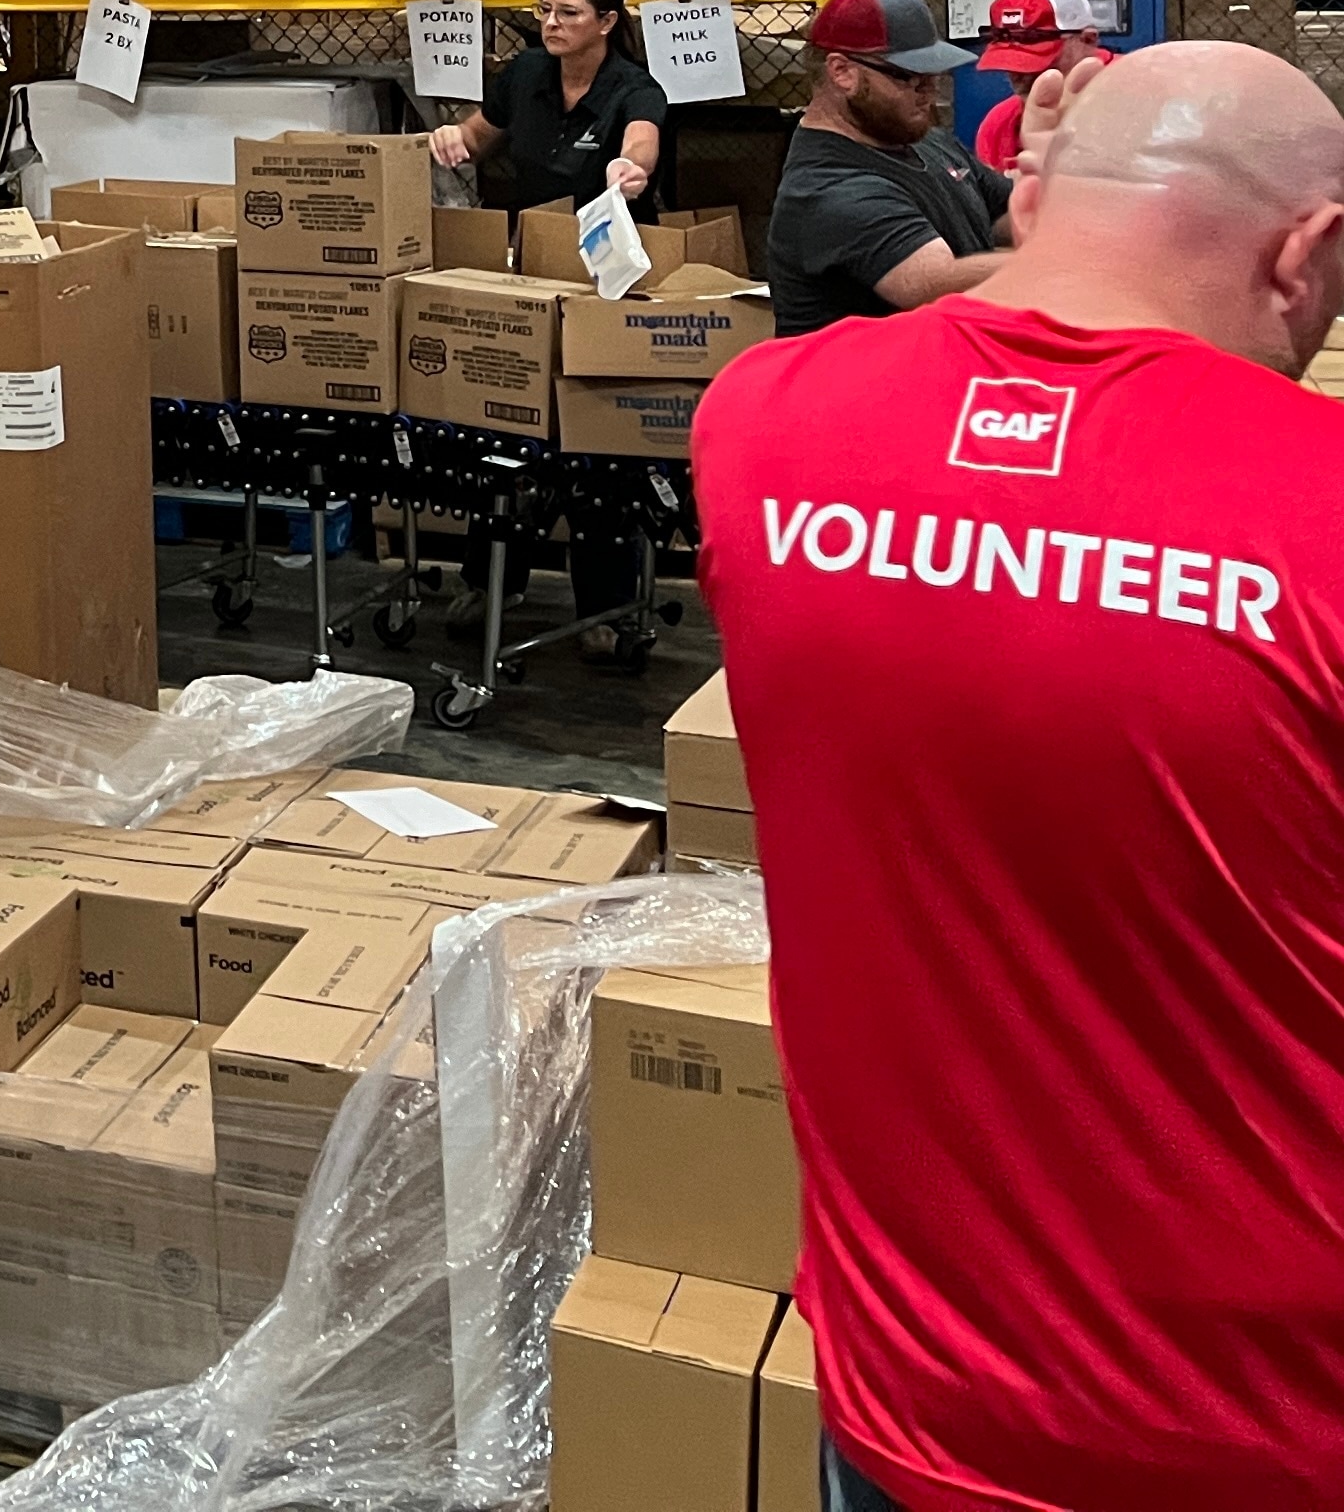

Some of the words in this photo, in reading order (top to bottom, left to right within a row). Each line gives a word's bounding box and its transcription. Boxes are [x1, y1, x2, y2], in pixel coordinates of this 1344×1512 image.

[103, 8, 141, 29] PASTA
[419, 11, 474, 23] POTATO
[654, 6, 721, 24] POWDER
[105, 33, 114, 44] 2
[117, 36, 133, 52] BX
[424, 32, 473, 45] FLAKES
[672, 29, 709, 42] MILK
[433, 54, 439, 65] 1
[444, 55, 469, 67] BAG
[670, 55, 677, 66] 1
[684, 50, 717, 65] BAG
[304, 168, 333, 178] POTATO
[336, 169, 365, 178] FLAKES
[256, 301, 305, 313] DEHYDRATED
[308, 303, 337, 314] POTATO
[339, 305, 369, 317] FLAKES
[419, 311, 468, 328] DEHYDRATED
[470, 317, 500, 332] POTATO
[503, 322, 533, 336] FLAKES
[625, 311, 731, 329] mountain
[652, 330, 707, 347] maid
[616, 394, 700, 410] mountai
[968, 409, 1058, 442] GAF
[763, 497, 1281, 643] VOLUNTEER
[228, 928, 256, 939] WHITE
[209, 954, 253, 973] Food
[16, 987, 59, 1042] Balanced
